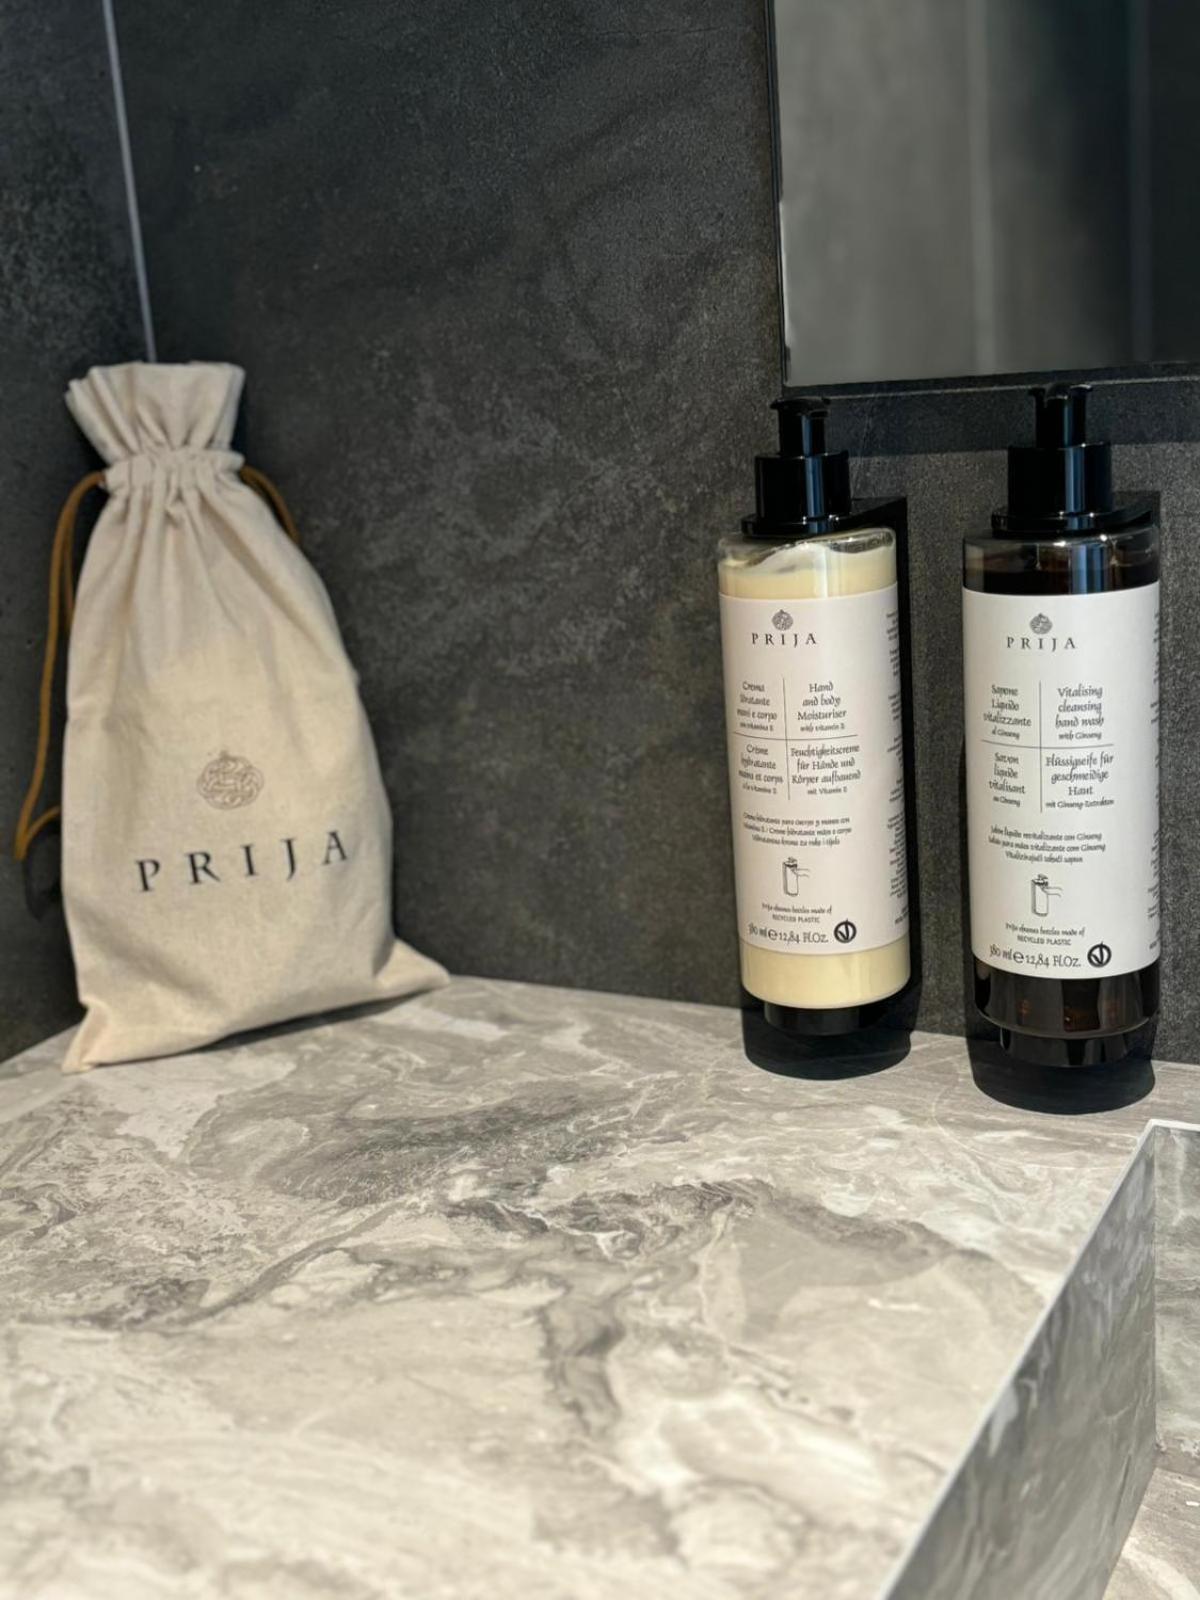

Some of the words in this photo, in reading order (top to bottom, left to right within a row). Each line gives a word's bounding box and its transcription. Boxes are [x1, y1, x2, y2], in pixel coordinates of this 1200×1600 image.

[752, 633, 817, 647] PRIJA
[1007, 637, 1076, 651] PRIJA
[809, 681, 833, 692] Hand
[1058, 683, 1103, 699] Vitalising
[802, 697, 818, 706] and
[820, 694, 841, 707] body
[1058, 699, 1102, 714] cleansing
[1055, 714, 1079, 729] hand
[841, 757, 855, 767] und
[1068, 786, 1093, 795] Haut
[135, 831, 349, 892] PRIJA
